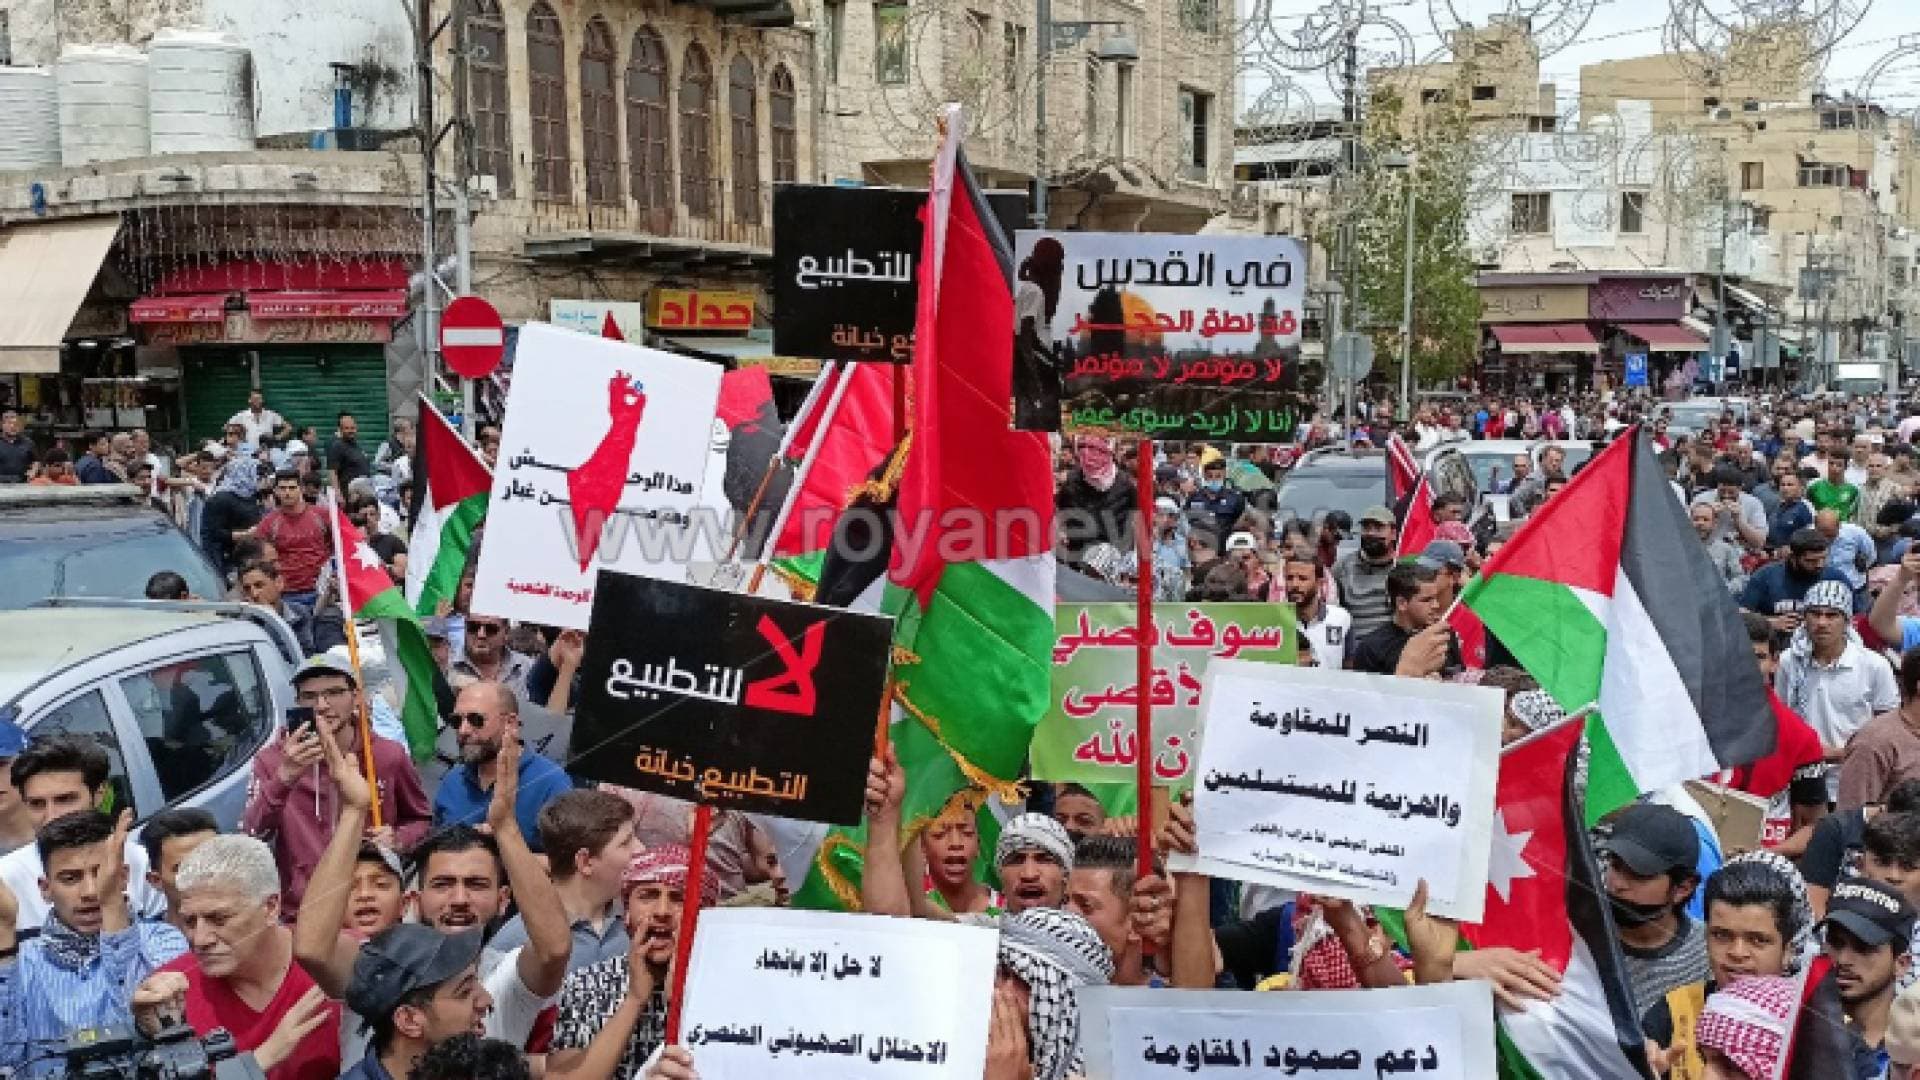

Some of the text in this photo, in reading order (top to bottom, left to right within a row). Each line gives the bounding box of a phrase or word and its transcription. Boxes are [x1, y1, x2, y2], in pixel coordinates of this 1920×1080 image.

[796, 248, 911, 289] للتطبيع
[1076, 250, 1292, 295] في القدس
[661, 292, 751, 325] حداد
[1260, 310, 1297, 335] قد
[831, 323, 886, 353] خيانة
[1065, 351, 1282, 384] لا مؤتمر لا مؤتمر
[1121, 407, 1184, 432] سوى
[1191, 404, 1238, 436] أريد
[1245, 409, 1263, 431] لا
[1268, 404, 1292, 432] أنا
[502, 477, 536, 500] غبار
[666, 474, 694, 493] هذا
[1165, 609, 1283, 658] سوف
[605, 656, 743, 705] للتطبيع
[745, 613, 828, 716] لا
[1250, 701, 1429, 748] النصر للمقاومة
[634, 745, 808, 801] التطبيع خيانة
[1204, 769, 1461, 828] والهزيمة للمستسلمين
[1833, 882, 1900, 914] Supreme
[810, 949, 828, 981] إلا
[869, 954, 883, 978] لا
[767, 1026, 865, 1059] الصهيوني
[867, 1035, 949, 1064] الاحتلال
[1142, 1035, 1439, 1080] دعم صمود المقاومة
